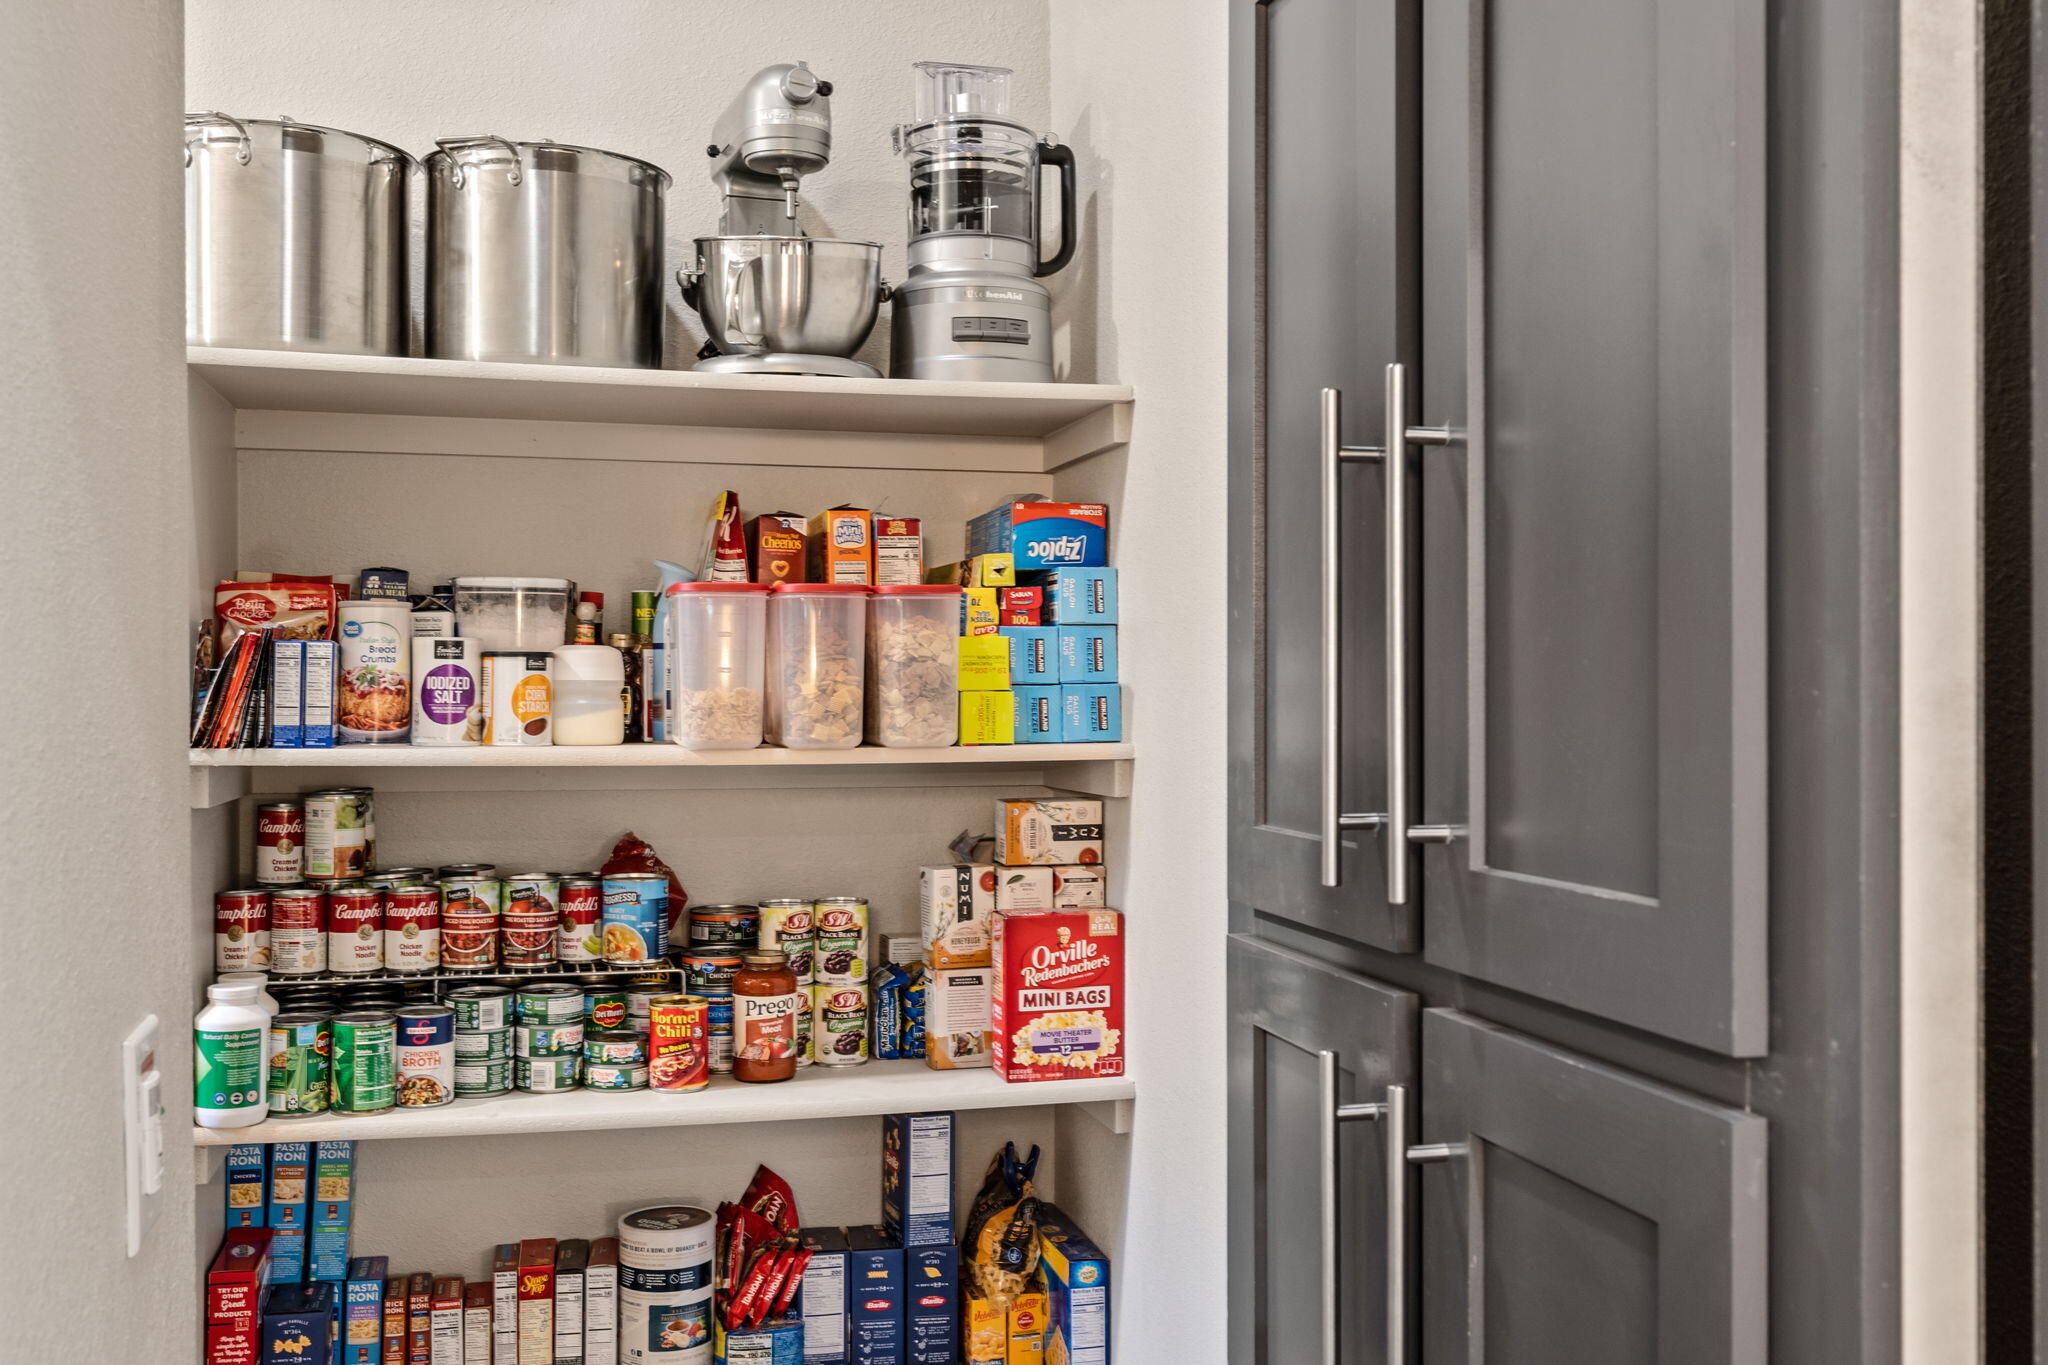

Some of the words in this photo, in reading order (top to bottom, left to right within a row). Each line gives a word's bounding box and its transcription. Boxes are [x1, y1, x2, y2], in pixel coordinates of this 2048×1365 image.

[837, 525, 862, 535] Mini
[762, 535, 802, 549] Cheerios
[1028, 536, 1081, 561] Ziploc
[233, 598, 266, 611] Betty
[226, 607, 273, 619] Crocker
[1012, 615, 1028, 625] 100
[975, 625, 998, 635] GLAD
[369, 645, 396, 653] Bread
[360, 655, 396, 663] Crumbs
[427, 676, 470, 690] IODIZED
[434, 691, 463, 704] SALT
[525, 690, 547, 700] CORN
[1058, 827, 1099, 839] NUMI
[959, 872, 972, 914] NUMI
[385, 901, 438, 920] Campbell's
[1091, 923, 1116, 931] REAL
[782, 932, 801, 941] BLACK
[820, 930, 836, 938] BLACK
[820, 939, 856, 951] Organic
[1031, 939, 1098, 969] Orville
[1021, 954, 1111, 987] Redenbacher's
[1023, 992, 1060, 1008] MINI
[1065, 989, 1106, 1005] BAGS
[745, 998, 794, 1018] Prego
[651, 1010, 700, 1024] Hormel
[656, 1024, 691, 1038] Chili
[761, 1025, 782, 1034] Meat
[829, 1021, 863, 1032] Organic
[404, 1050, 440, 1058] CHICKEN
[1060, 1045, 1072, 1054] 12
[402, 1057, 441, 1067] BROTH
[275, 1143, 306, 1152] PASTA
[320, 1141, 350, 1150] PASTA
[229, 1147, 261, 1156] PASTA
[320, 1150, 350, 1160] RONI
[230, 1156, 261, 1166] RONI
[275, 1152, 306, 1162] RONI
[348, 1283, 379, 1292] PASTA
[521, 1274, 549, 1293] Stove
[741, 1275, 765, 1306] IDAHOAN
[348, 1292, 379, 1303] RONI
[221, 1299, 246, 1311] Great
[866, 1301, 890, 1309] Barilla
[214, 1310, 252, 1318] PRODUCTS
